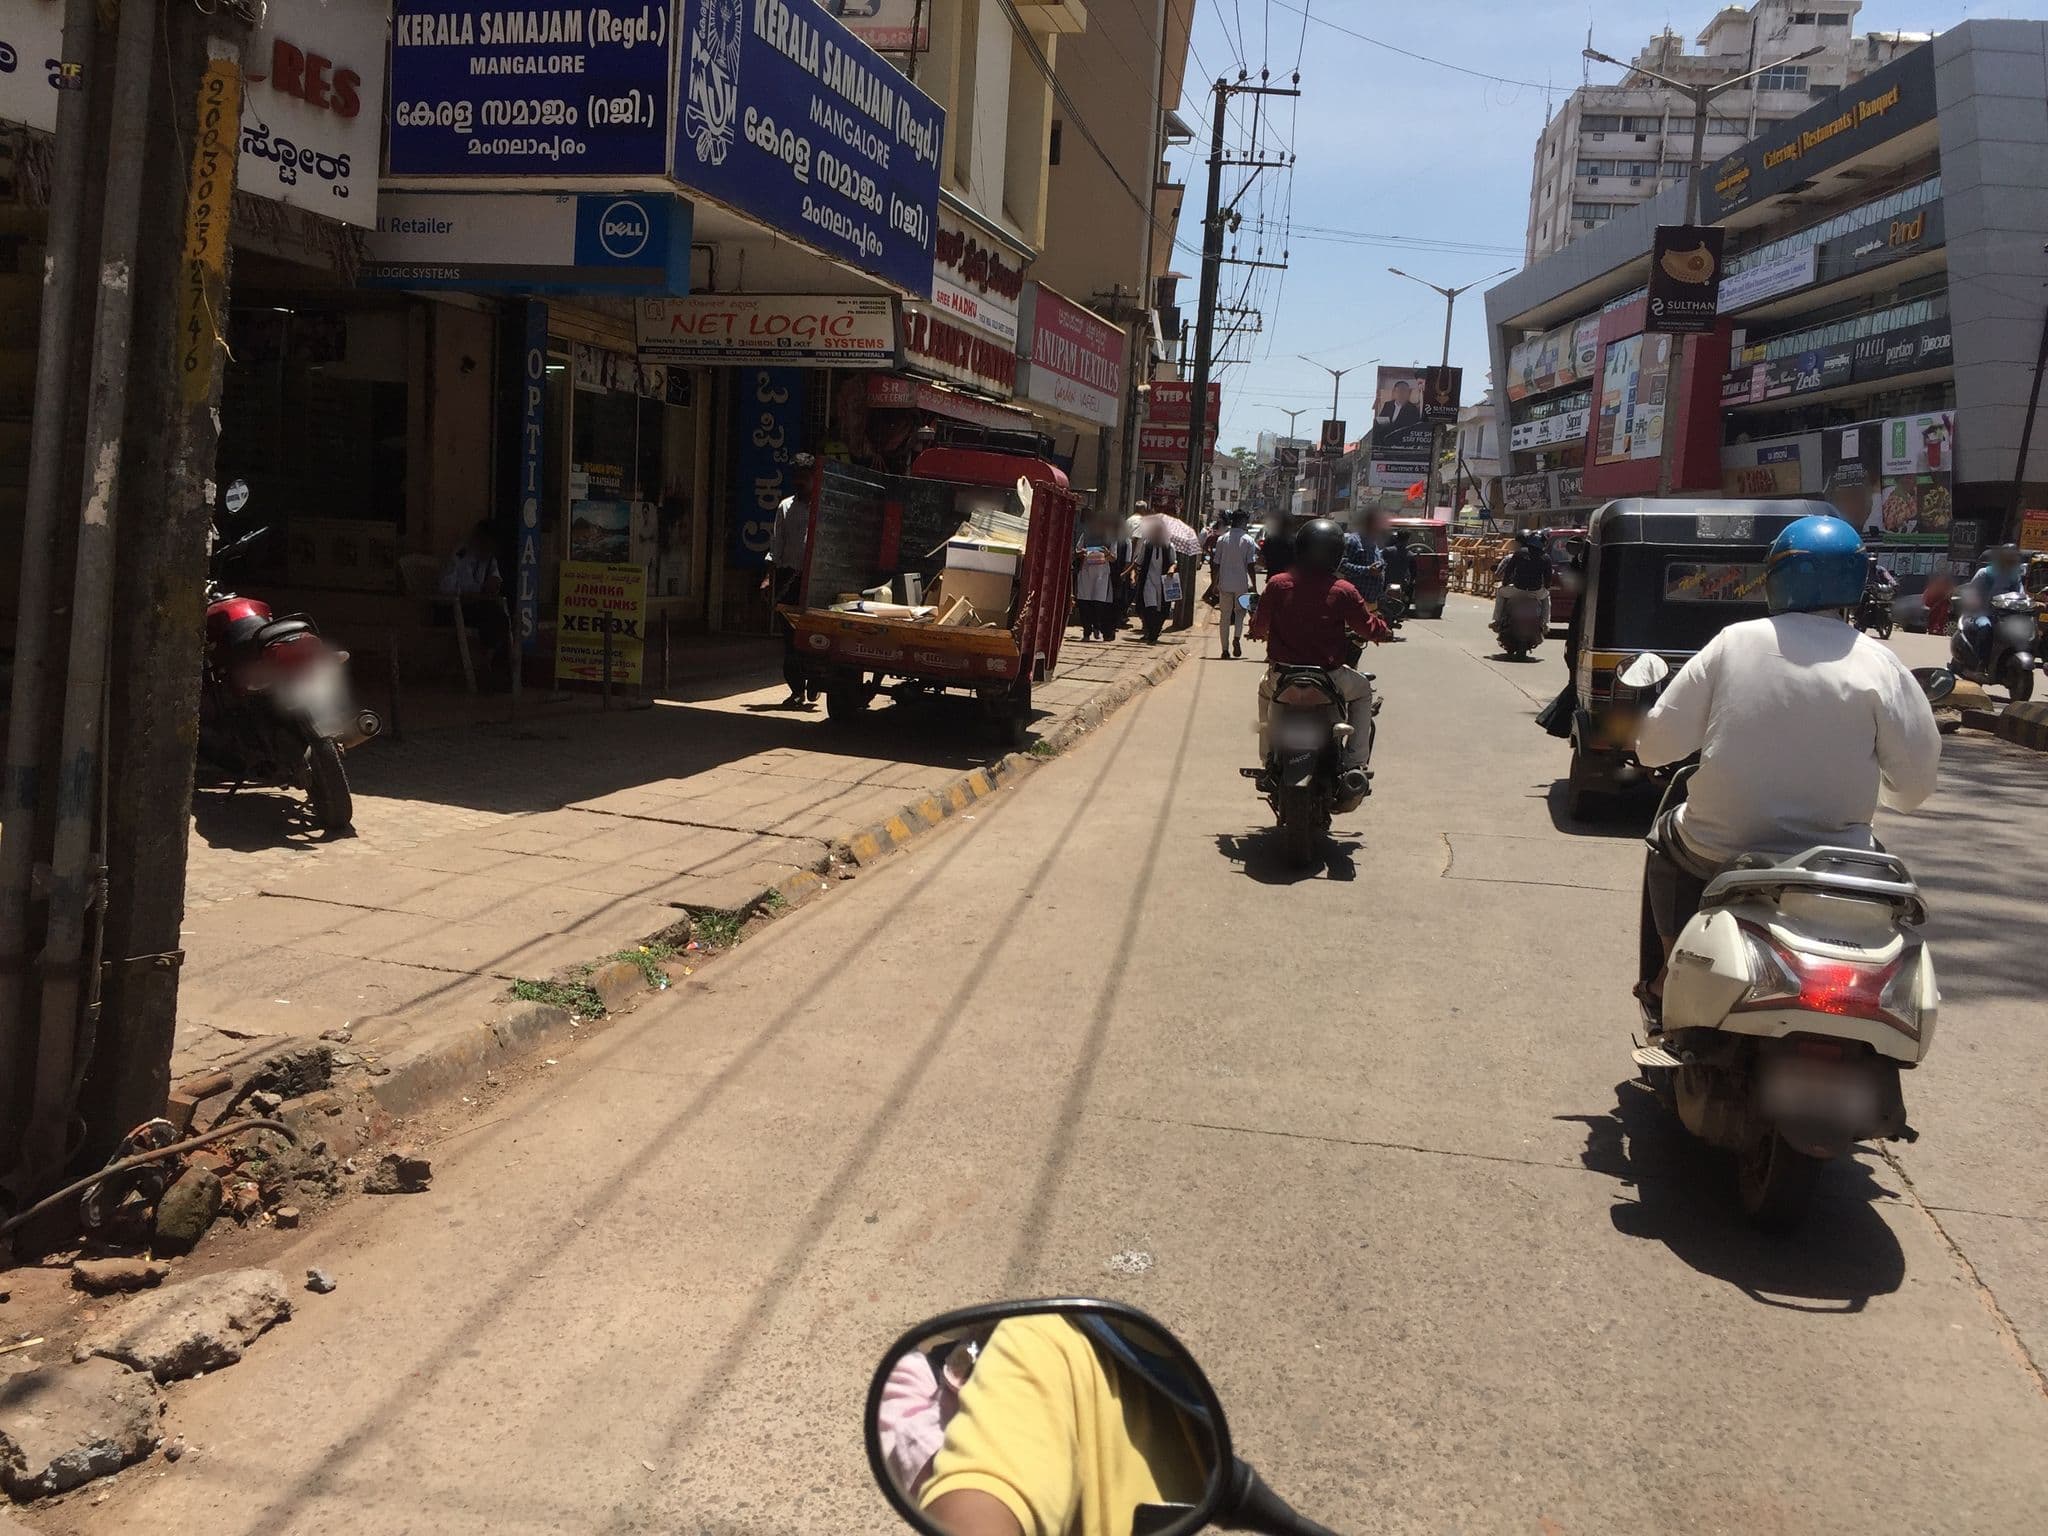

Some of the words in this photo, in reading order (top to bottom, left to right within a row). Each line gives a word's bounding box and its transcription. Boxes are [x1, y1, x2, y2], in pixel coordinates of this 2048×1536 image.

[397, 9, 474, 46] KERALA
[480, 9, 582, 46] SAMAJAM
[589, 6, 664, 49] (Regd.)
[470, 55, 584, 75] MANGALORE
[753, 0, 819, 77] KERALA
[822, 29, 894, 131] SAMAJAM
[895, 87, 939, 170] (Regd.)
[396, 100, 473, 129] കേരള
[481, 100, 577, 125] സമാജം
[588, 91, 655, 129] (റജി.)
[809, 95, 891, 171] MANGALORE
[1763, 141, 1798, 169] Catering
[1802, 112, 1853, 150] Restaurants
[1858, 85, 1901, 121] Banquet
[467, 136, 586, 160] മംഗലാപുരം
[743, 107, 809, 183] കേരള
[816, 152, 883, 215] സമാജം
[391, 217, 453, 235] Retailer
[605, 222, 643, 237] DELL
[801, 196, 884, 257] മംഗലാപുരം
[377, 267, 410, 280] LOGIC
[413, 267, 460, 280] SYSTEMS
[951, 292, 978, 320] MADHU
[1667, 300, 1716, 311] SULTHAN
[671, 313, 738, 335] NET
[749, 314, 856, 340] LOGIC
[824, 338, 885, 349] SYSTEMS
[1035, 327, 1077, 376] ANUPAM
[1079, 348, 1120, 392] TEXTILES
[1796, 368, 1822, 391] Zeds
[1156, 385, 1184, 403] STEP
[1142, 430, 1174, 449] STEP
[521, 347, 544, 638] OPTICALS
[574, 583, 625, 597] JANAKA
[563, 595, 598, 609] AUTO
[603, 598, 638, 611] LINKS
